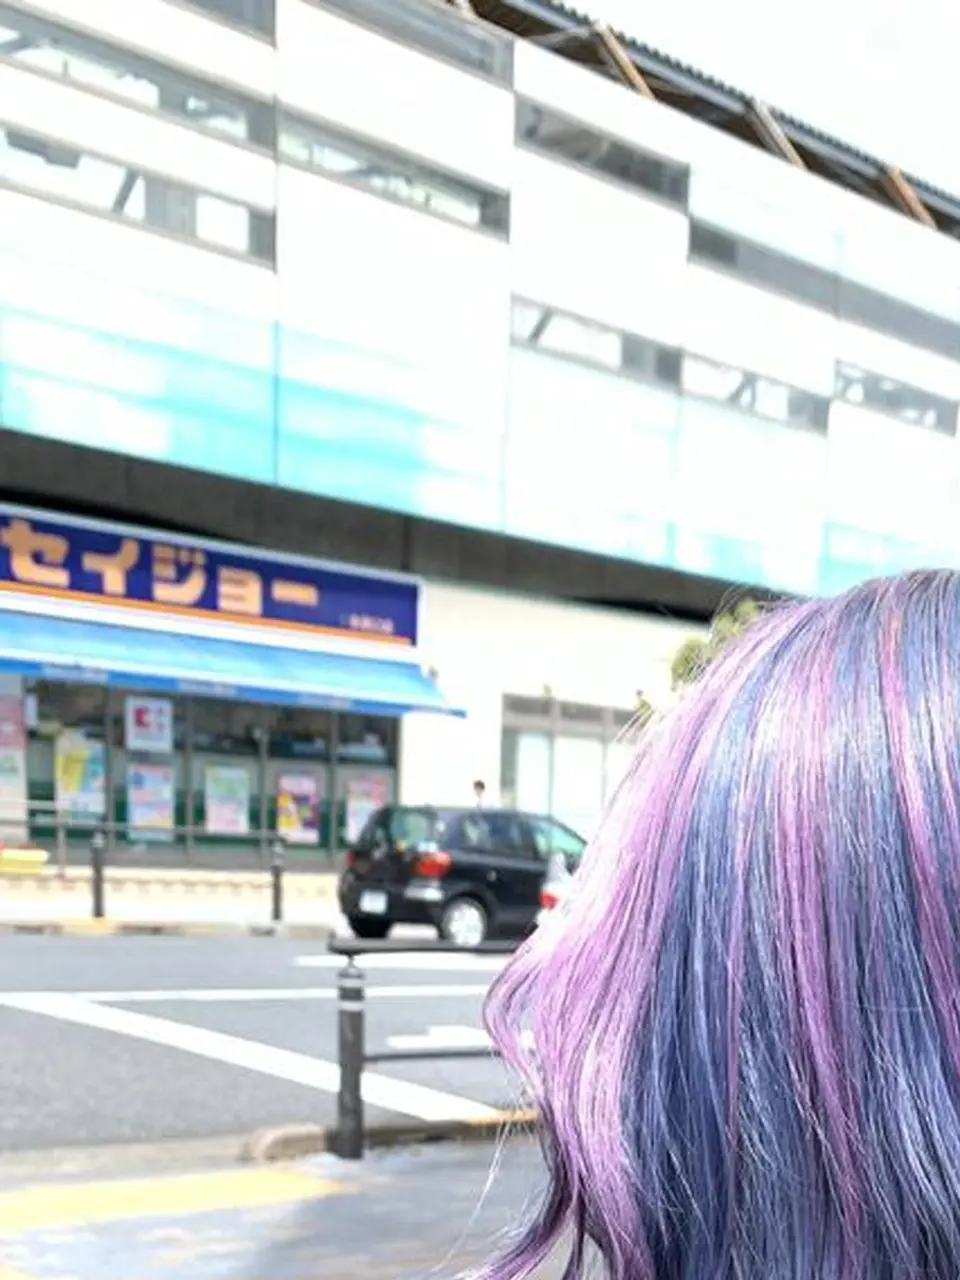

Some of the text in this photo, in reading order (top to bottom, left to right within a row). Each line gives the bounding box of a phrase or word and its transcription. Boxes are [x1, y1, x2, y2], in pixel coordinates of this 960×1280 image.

[1, 519, 319, 616] セイジョー
